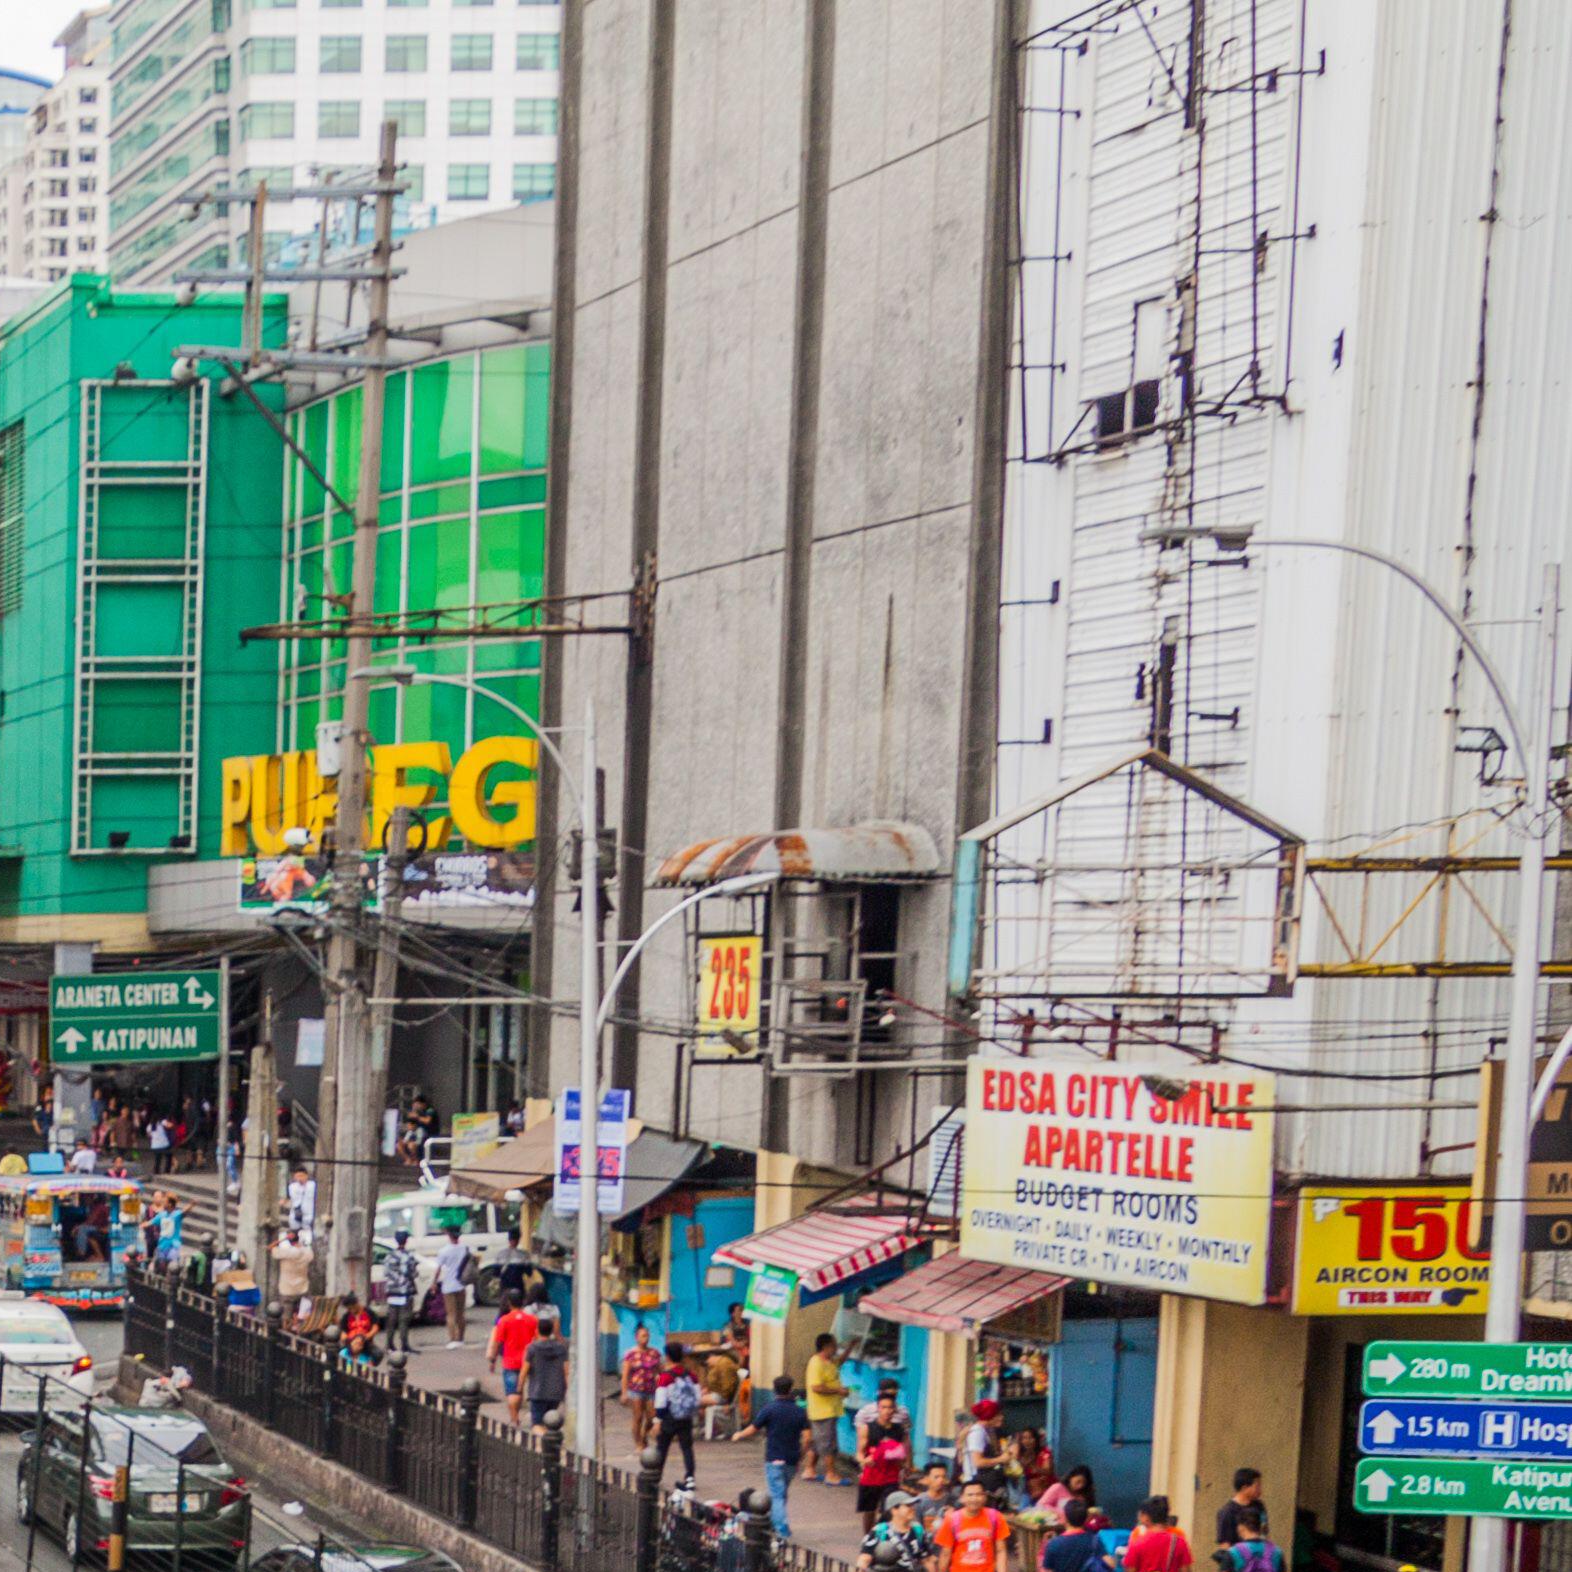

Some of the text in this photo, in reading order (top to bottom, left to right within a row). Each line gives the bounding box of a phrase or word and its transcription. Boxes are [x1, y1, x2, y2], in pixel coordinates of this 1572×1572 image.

[55, 985, 121, 1008] ARANETA
[123, 981, 179, 1006] CENTER
[709, 945, 752, 1021] 235
[91, 1025, 197, 1052] KATIPUNAN
[982, 1069, 1255, 1131] EDSA CITY SMILE
[1023, 1124, 1196, 1183] APARTELLE
[1014, 1178, 1199, 1225] BUDGET ROOMS
[970, 1208, 1253, 1265] OVERNIGHT DAILY WEEKLY MONTHLY
[1014, 1239, 1190, 1284] PRIVATE CR TV AIRCON
[1315, 1266, 1408, 1286] AIRCON
[1347, 1288, 1436, 1306] THIS WAY
[1409, 1359, 1448, 1380] 280
[1450, 1364, 1470, 1380] m
[1406, 1416, 1434, 1438] 1.5
[1436, 1416, 1469, 1438] km
[1401, 1476, 1431, 1496] 2.8
[1433, 1475, 1465, 1497] km
